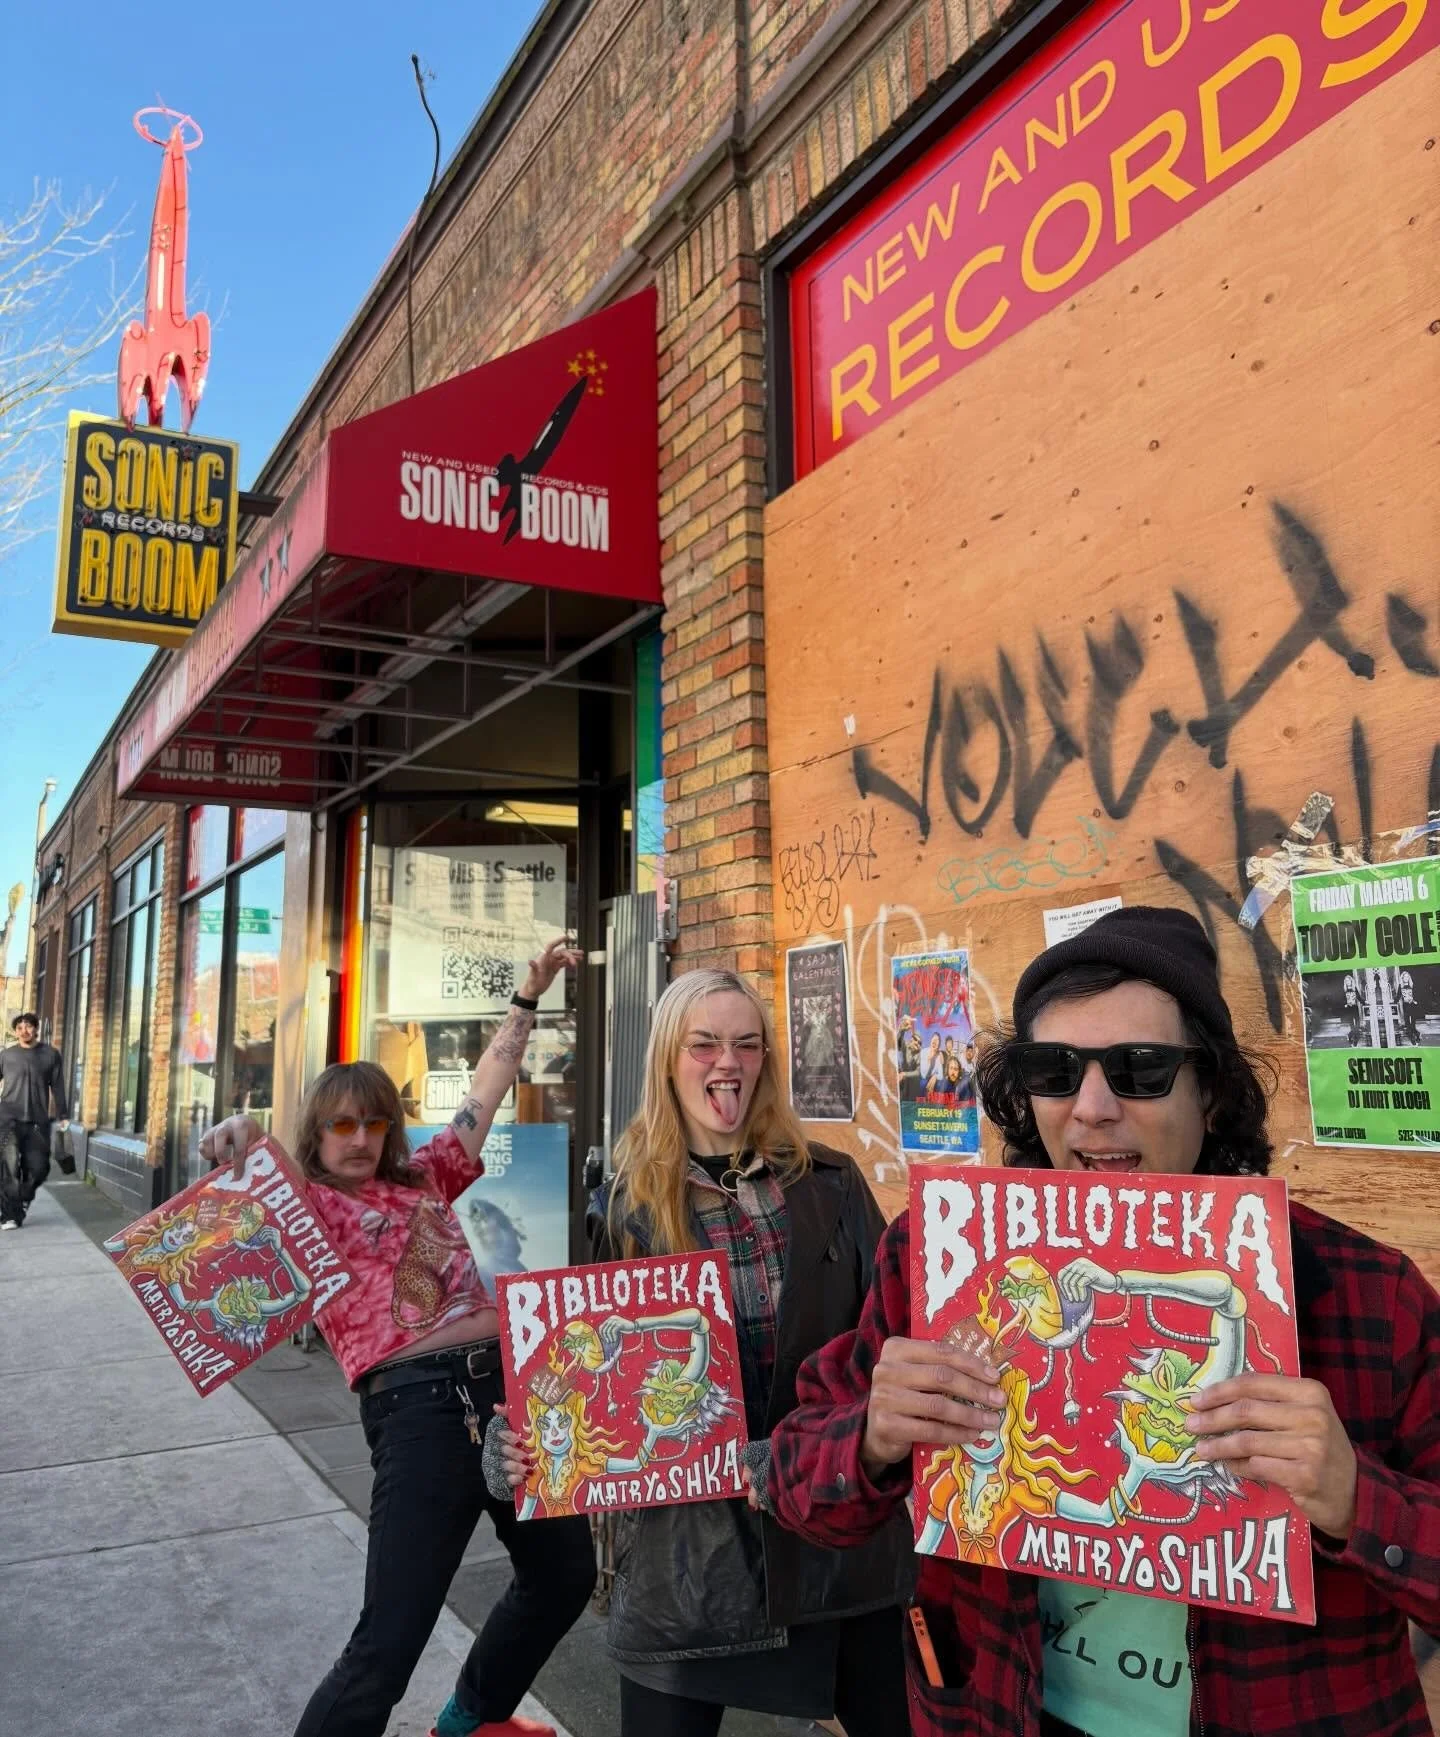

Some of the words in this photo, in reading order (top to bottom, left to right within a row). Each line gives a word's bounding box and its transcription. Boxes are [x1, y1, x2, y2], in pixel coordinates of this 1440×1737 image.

[843, 184, 960, 321] NEW
[978, 59, 1117, 213] AND
[829, 0, 1428, 441] RECORDS
[401, 450, 433, 464] NEW
[436, 457, 463, 470] AND
[466, 463, 500, 476] USED
[520, 472, 575, 491] RECORDS
[101, 511, 206, 543] RECORDS
[520, 483, 610, 553] BOOM
[76, 527, 221, 621] BOOM
[1309, 884, 1355, 912] FRIDAY
[1358, 875, 1414, 907] MARCH
[1417, 874, 1429, 900] 6
[1298, 918, 1368, 963] TOODY
[1375, 912, 1438, 957] COLE
[1347, 1057, 1424, 1086] SEMISOFT
[917, 1107, 954, 1118] FEBRUARY
[1347, 1089, 1361, 1109] DJ
[1361, 1089, 1390, 1110] KURT
[1391, 1090, 1432, 1110] BLOCH
[913, 1120, 940, 1132] SUNSET
[940, 1122, 968, 1133] TAVERN
[950, 1136, 963, 1146] WA
[211, 1146, 351, 1317] BIBLIOTEKA
[922, 1178, 1291, 1325] BIBLIOTEKA
[137, 1278, 236, 1389] MATRYOSHKA
[505, 1259, 733, 1377] BIBLIOTEKA
[585, 1438, 743, 1508] MATRYOSHKA
[1018, 1513, 1297, 1611] MATRYOSHKA
[1118, 1650, 1193, 1689] OU
